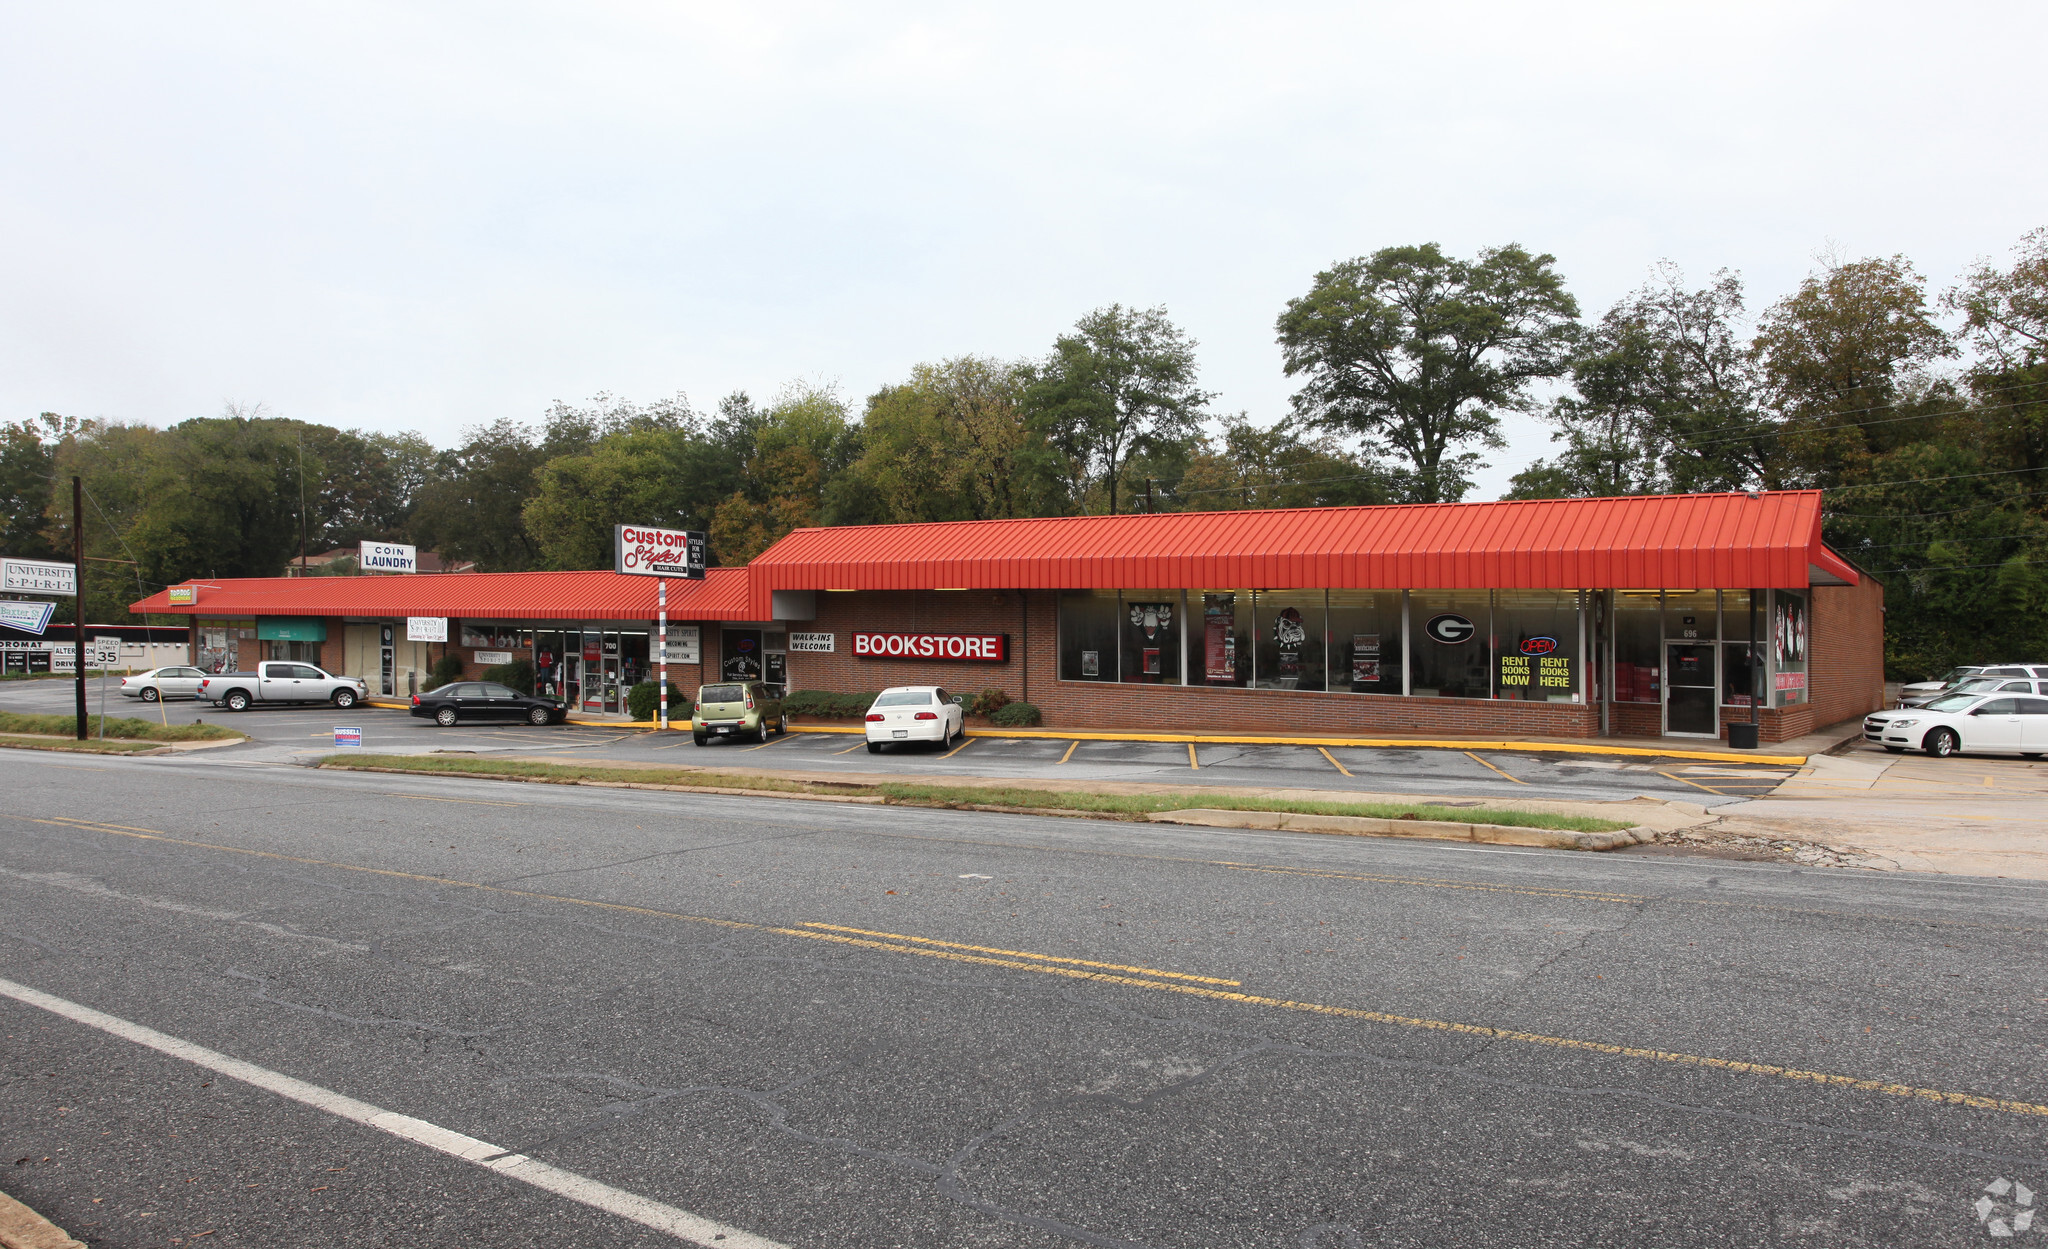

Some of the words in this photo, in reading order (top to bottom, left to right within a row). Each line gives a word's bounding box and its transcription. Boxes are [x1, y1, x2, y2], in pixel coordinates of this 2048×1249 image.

[623, 528, 687, 548] Custom
[375, 547, 404, 555] COIN
[365, 556, 413, 568] LAUNDRY
[624, 545, 684, 570] Styles
[9, 566, 74, 578] UNIVERSITY
[0, 607, 29, 616] Baxter
[855, 634, 997, 658] BOOKSTORE
[1520, 640, 1555, 652] OPEN
[98, 652, 116, 662] 35
[1502, 656, 1530, 666] RENT
[724, 656, 744, 667] Custom
[744, 656, 760, 670] Styles
[1540, 658, 1570, 668] RENT
[1502, 666, 1530, 675] BOOKS
[1540, 668, 1569, 676] BOOKS
[1502, 676, 1530, 686] NOW
[1540, 676, 1570, 688] HERE
